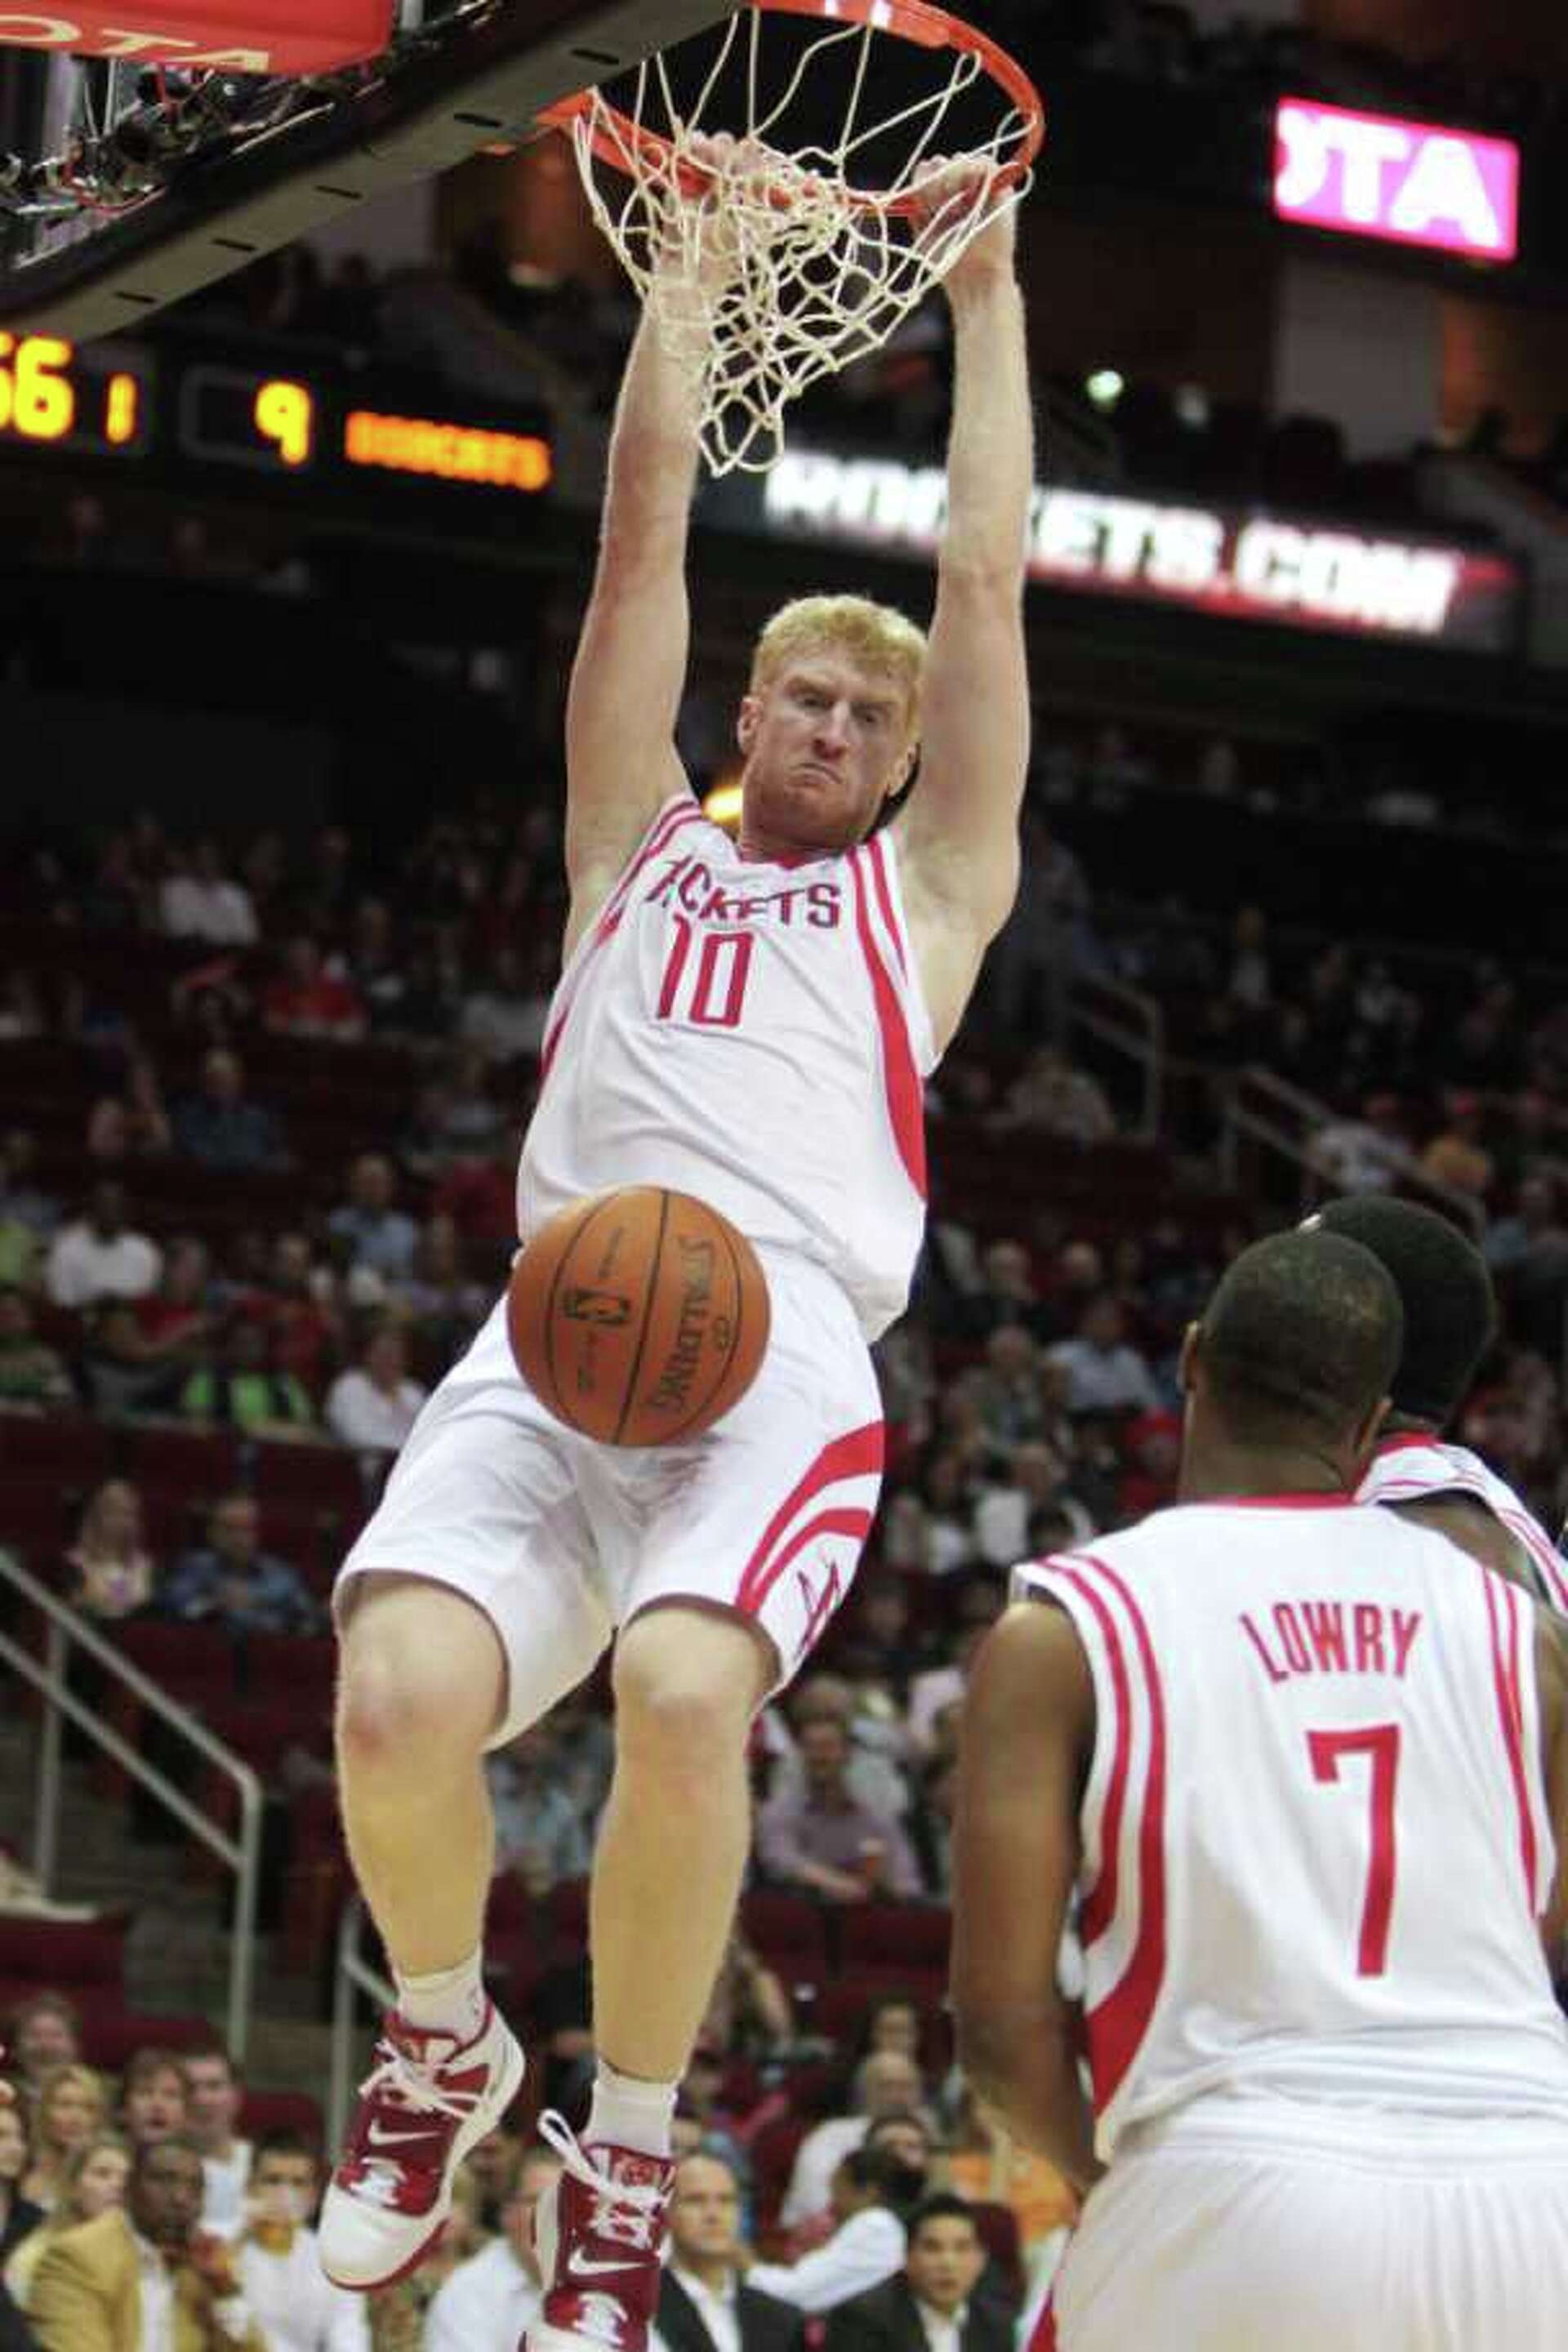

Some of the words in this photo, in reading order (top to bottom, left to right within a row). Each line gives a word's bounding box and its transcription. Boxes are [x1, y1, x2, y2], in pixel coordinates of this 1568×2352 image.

[0, 332, 75, 439] 6
[255, 381, 312, 464] 9
[766, 452, 1465, 635] ROCETS.COM
[644, 853, 841, 928] CKETS
[657, 911, 754, 1027] 10
[1238, 1601, 1421, 1684] LOWRY
[1306, 1723, 1401, 1977] 7
